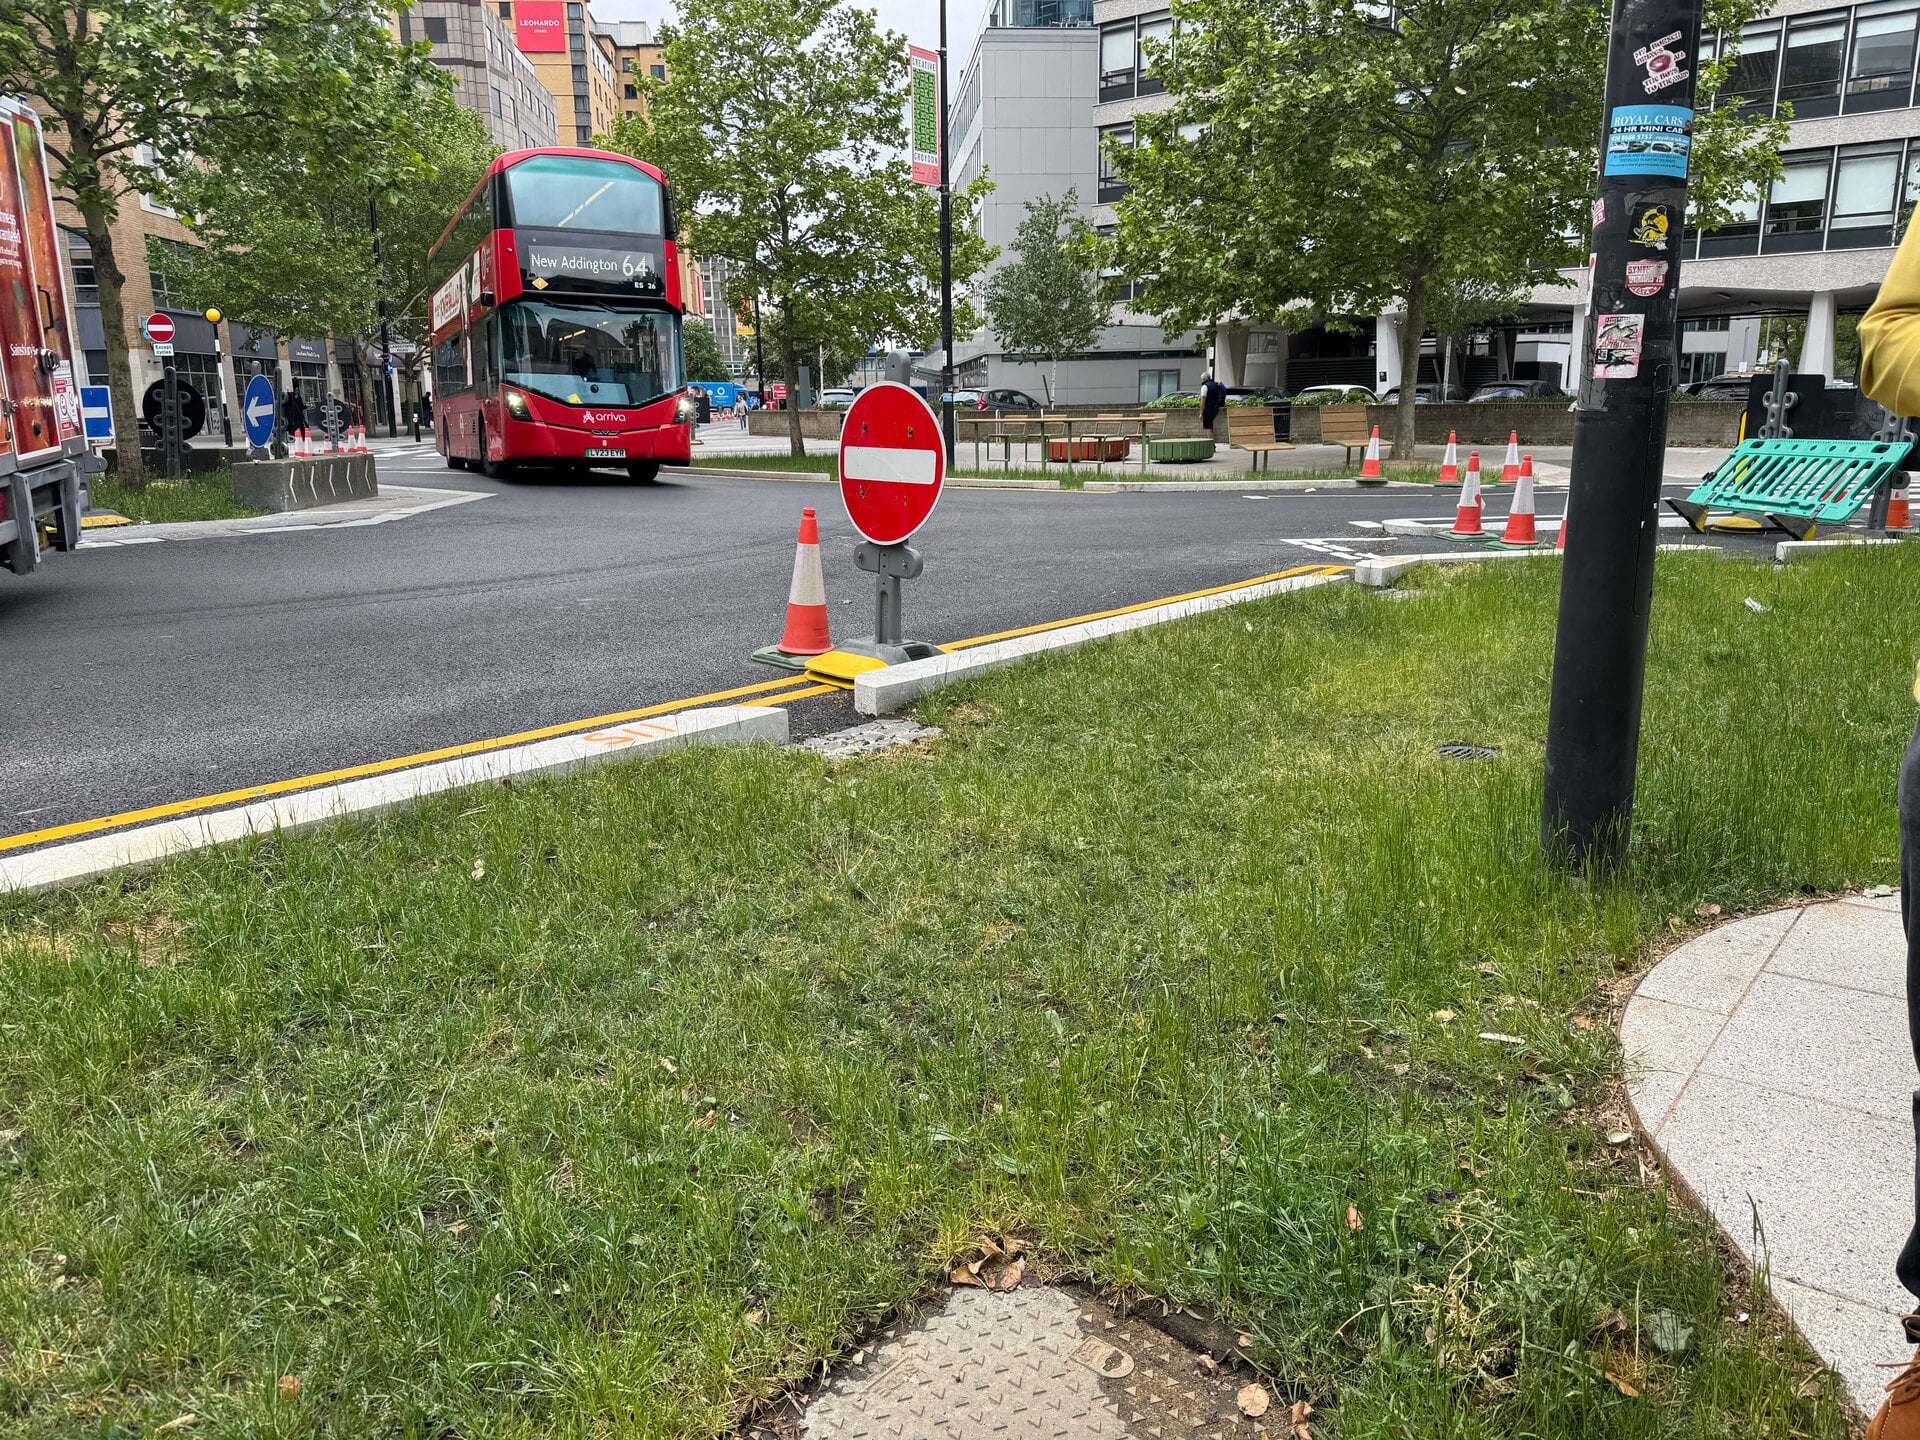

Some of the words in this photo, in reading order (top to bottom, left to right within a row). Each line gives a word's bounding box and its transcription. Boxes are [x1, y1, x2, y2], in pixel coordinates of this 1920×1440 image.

[1636, 48, 1664, 64] BRINGS
[1674, 52, 1685, 60] ALL
[912, 58, 936, 72] CREATIVE
[1644, 76, 1658, 86] THE
[1660, 68, 1679, 80] BOYS
[1658, 79, 1672, 88] THE
[1614, 115, 1650, 126] ROYAL
[1654, 115, 1683, 126] CARS
[914, 152, 938, 164] CROYDON
[531, 254, 557, 268] New
[560, 256, 618, 274] Addington
[622, 255, 648, 276] 64
[596, 412, 626, 422] arriva
